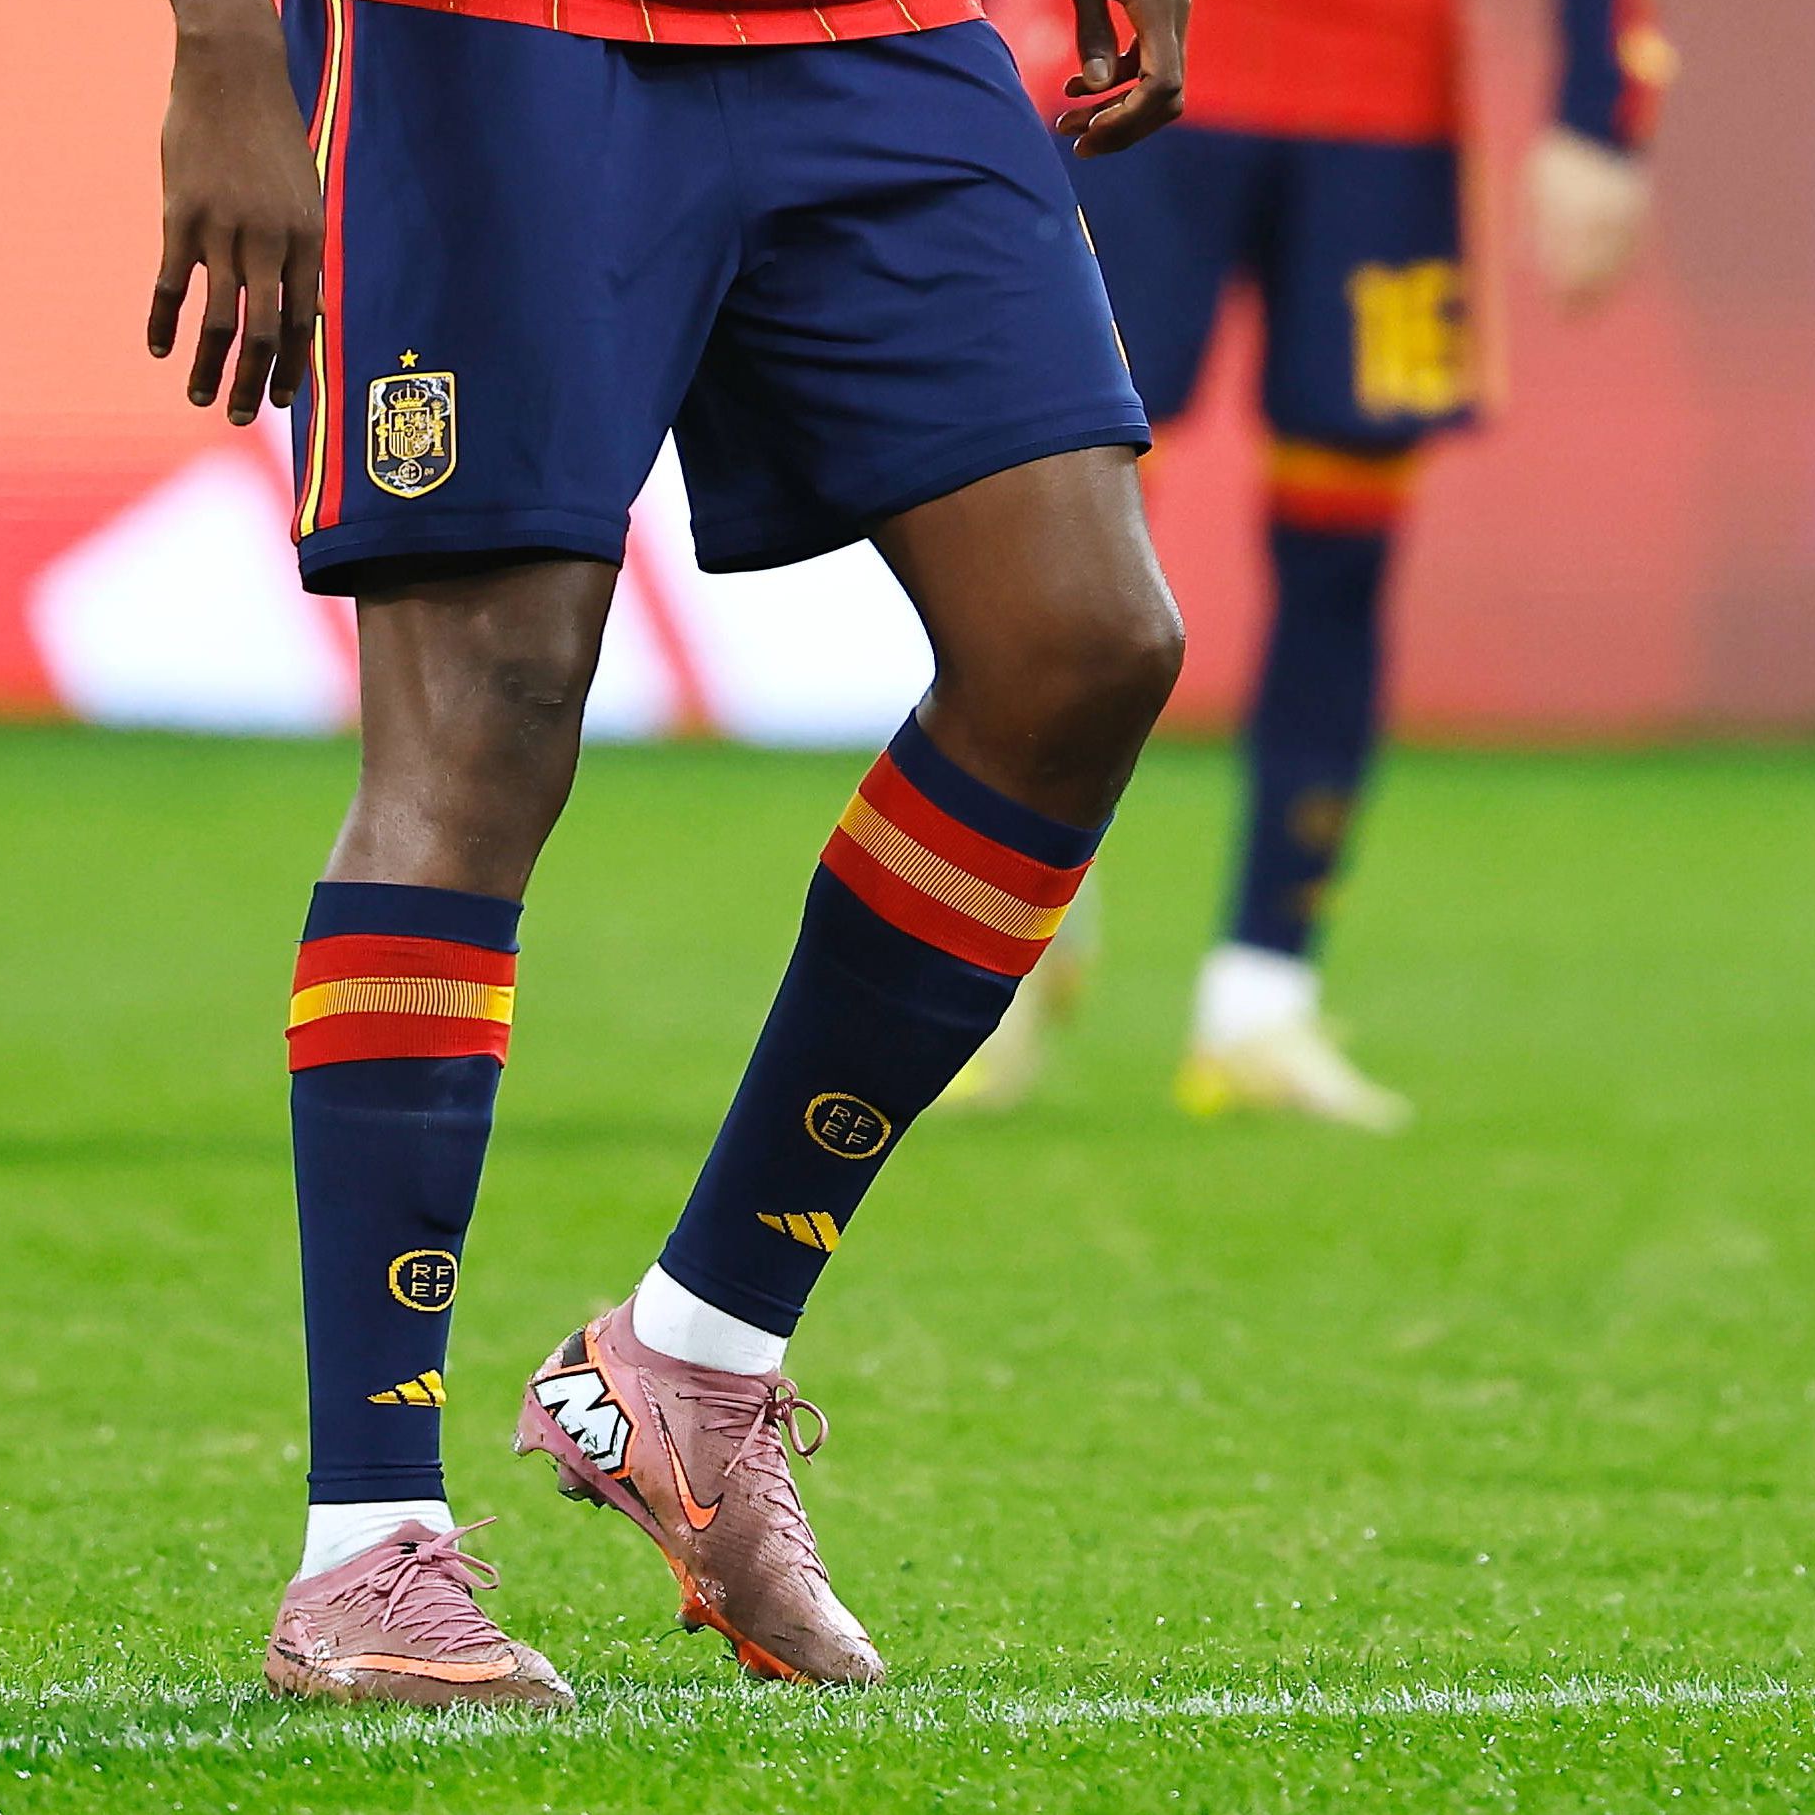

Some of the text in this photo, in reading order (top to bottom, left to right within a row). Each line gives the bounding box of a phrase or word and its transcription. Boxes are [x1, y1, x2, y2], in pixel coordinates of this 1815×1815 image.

[829, 1103, 876, 1128] RF
[820, 1120, 868, 1145] EF
[411, 1262, 453, 1280] RF
[410, 1281, 450, 1298] EF
